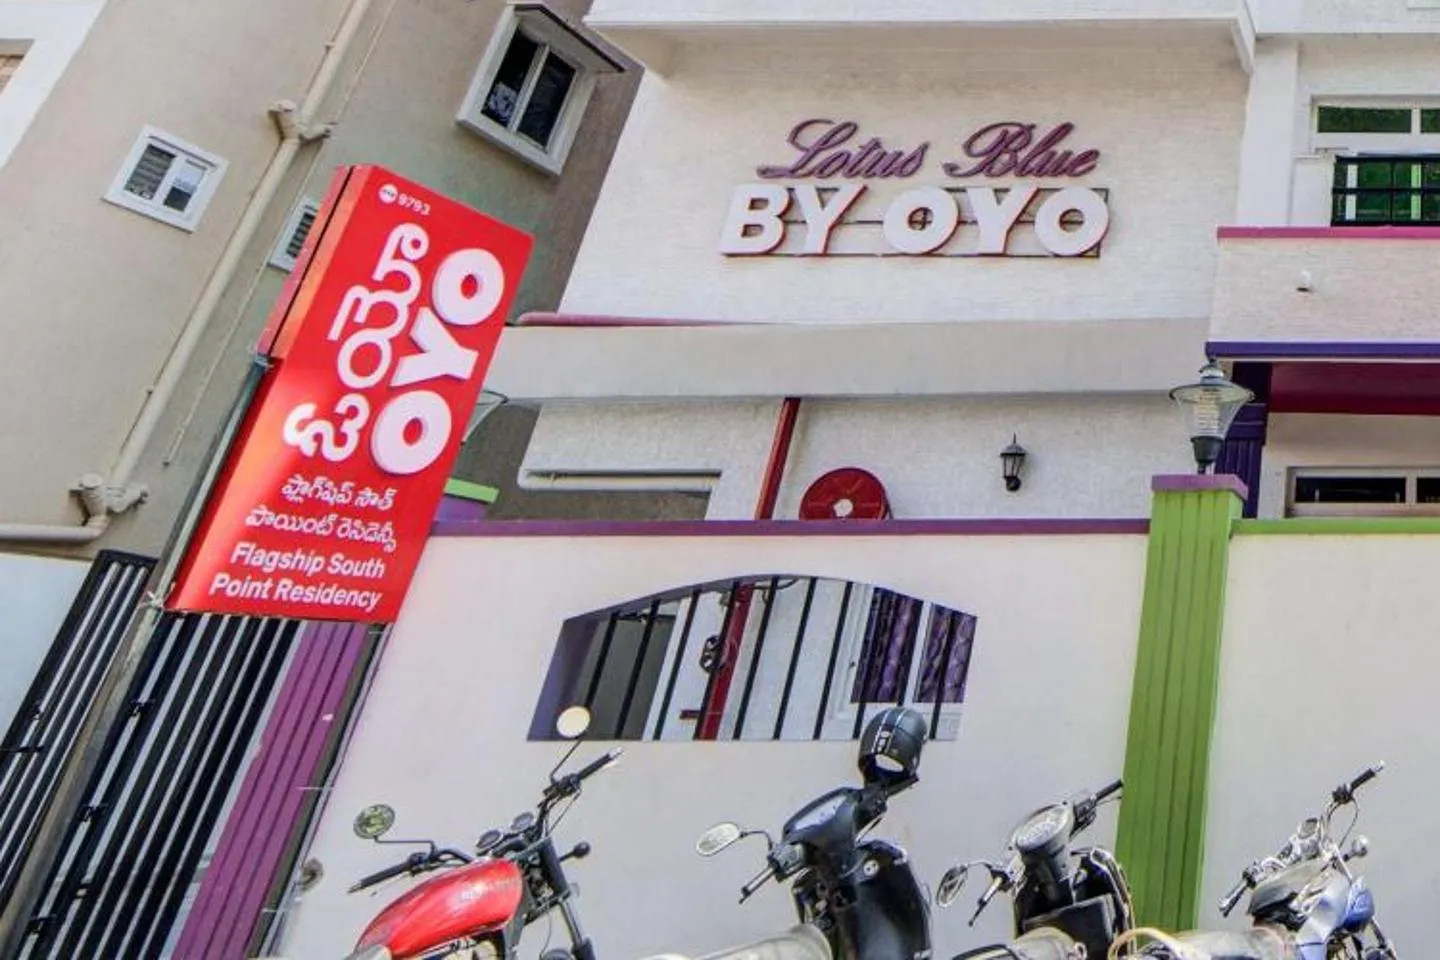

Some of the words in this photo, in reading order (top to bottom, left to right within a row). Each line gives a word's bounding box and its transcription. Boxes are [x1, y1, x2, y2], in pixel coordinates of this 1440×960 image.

[756, 118, 930, 180] Lotus
[943, 121, 1101, 180] Blue
[721, 185, 868, 257] BY
[882, 185, 1110, 257] OYO
[283, 222, 430, 462] ఓయో
[371, 247, 505, 475] OYO
[210, 574, 271, 601] Point
[276, 578, 382, 610] Residency
[230, 541, 326, 578] Flagship
[327, 553, 386, 578] South
